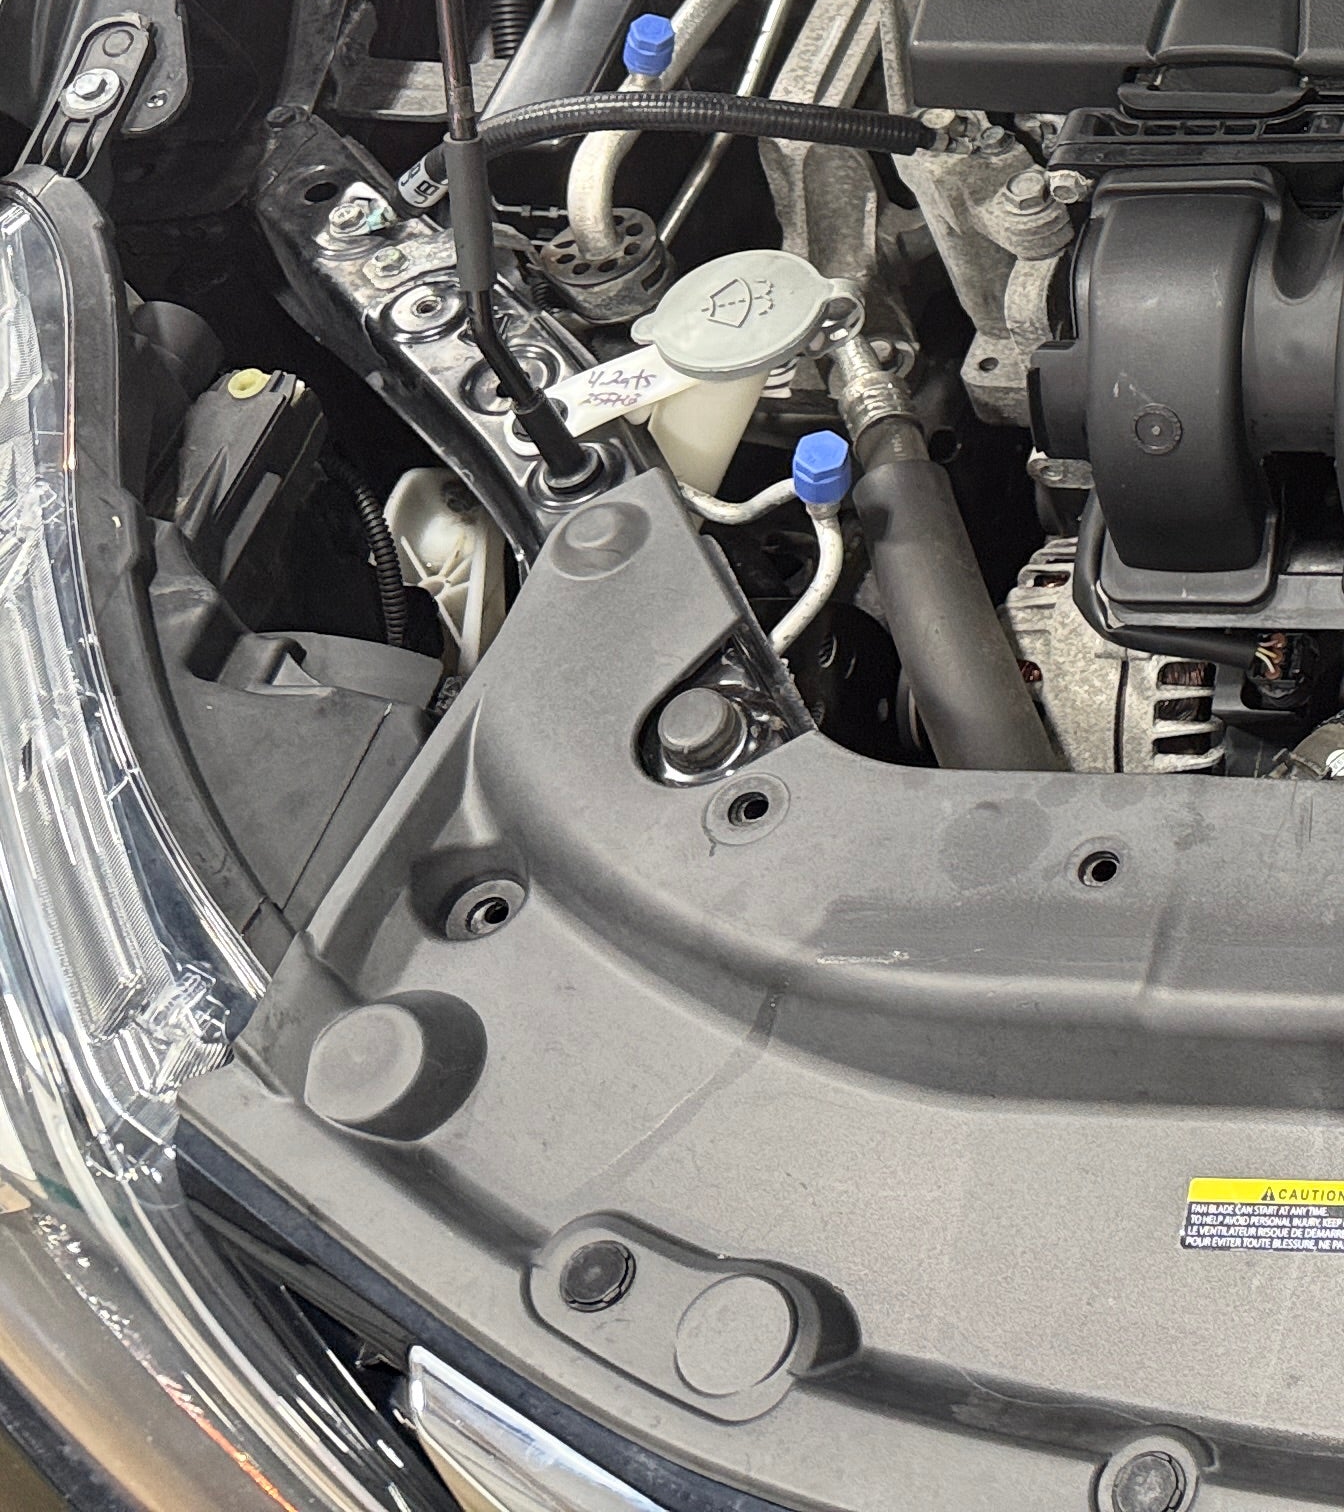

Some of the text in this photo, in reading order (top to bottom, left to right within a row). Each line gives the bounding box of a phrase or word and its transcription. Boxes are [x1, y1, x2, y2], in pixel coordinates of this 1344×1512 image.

[1191, 1204, 1207, 1213] FAN
[1208, 1204, 1234, 1214] BLADE
[1235, 1204, 1254, 1214] CAN
[1254, 1205, 1278, 1215] START
[1279, 1206, 1290, 1215] AT
[1191, 1215, 1202, 1224] TO
[1202, 1215, 1223, 1225] HELP
[1223, 1216, 1249, 1226] AVOID
[1250, 1216, 1291, 1227] PERSONAL
[1323, 1218, 1342, 1227] KEEP
[1188, 1226, 1198, 1235] LE
[1199, 1226, 1256, 1237] VENTILATEUR
[1257, 1227, 1290, 1238] RISQUE
[1291, 1228, 1303, 1238] DE
[1185, 1236, 1211, 1246] POUR
[1242, 1238, 1271, 1248] TOUTE
[1272, 1238, 1317, 1250] BLESSURE,
[1318, 1240, 1331, 1250] NE
